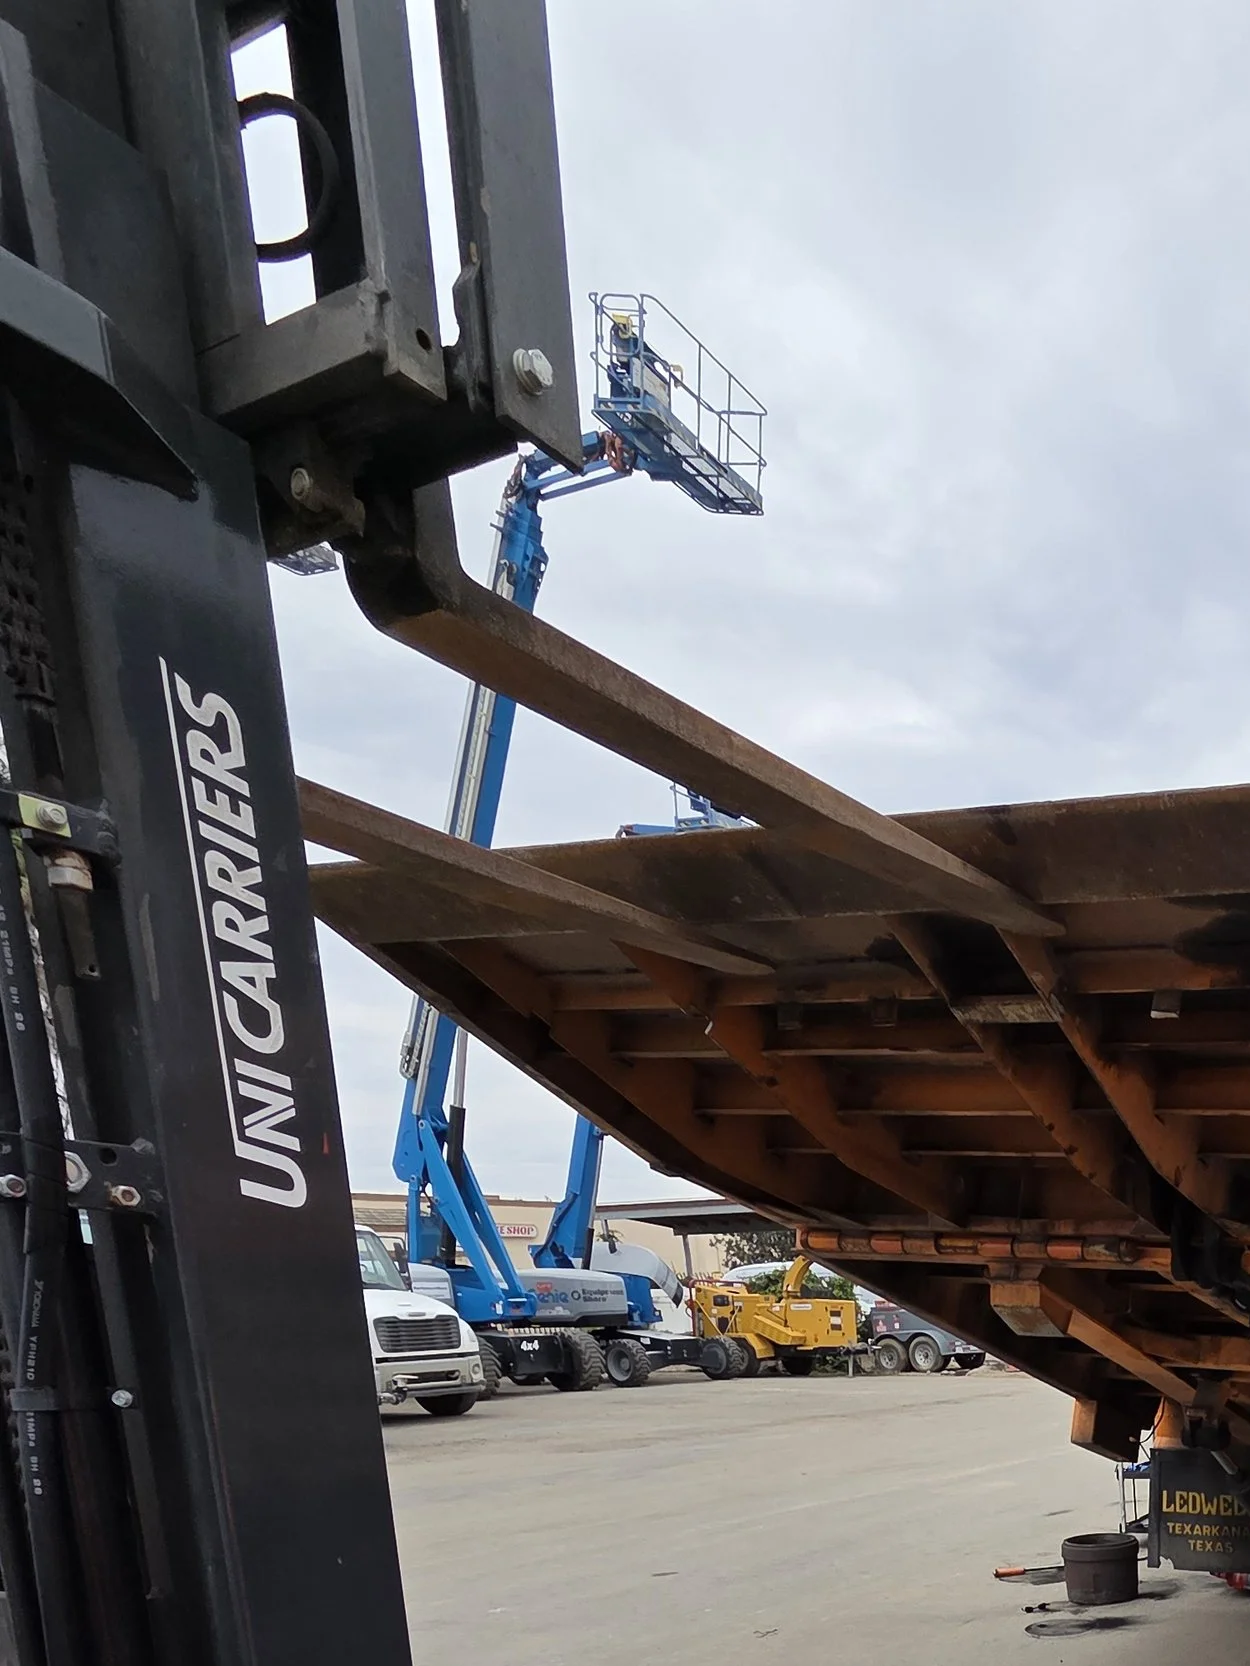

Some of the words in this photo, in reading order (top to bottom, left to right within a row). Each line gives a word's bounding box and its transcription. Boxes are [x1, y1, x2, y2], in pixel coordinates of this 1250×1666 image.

[162, 660, 307, 1208] UNICARRIERS
[506, 1226, 534, 1235] SHOP
[520, 1340, 540, 1351] 4x4
[1162, 1490, 1250, 1516] LEDWEL
[1188, 1539, 1233, 1553] TEXAS
